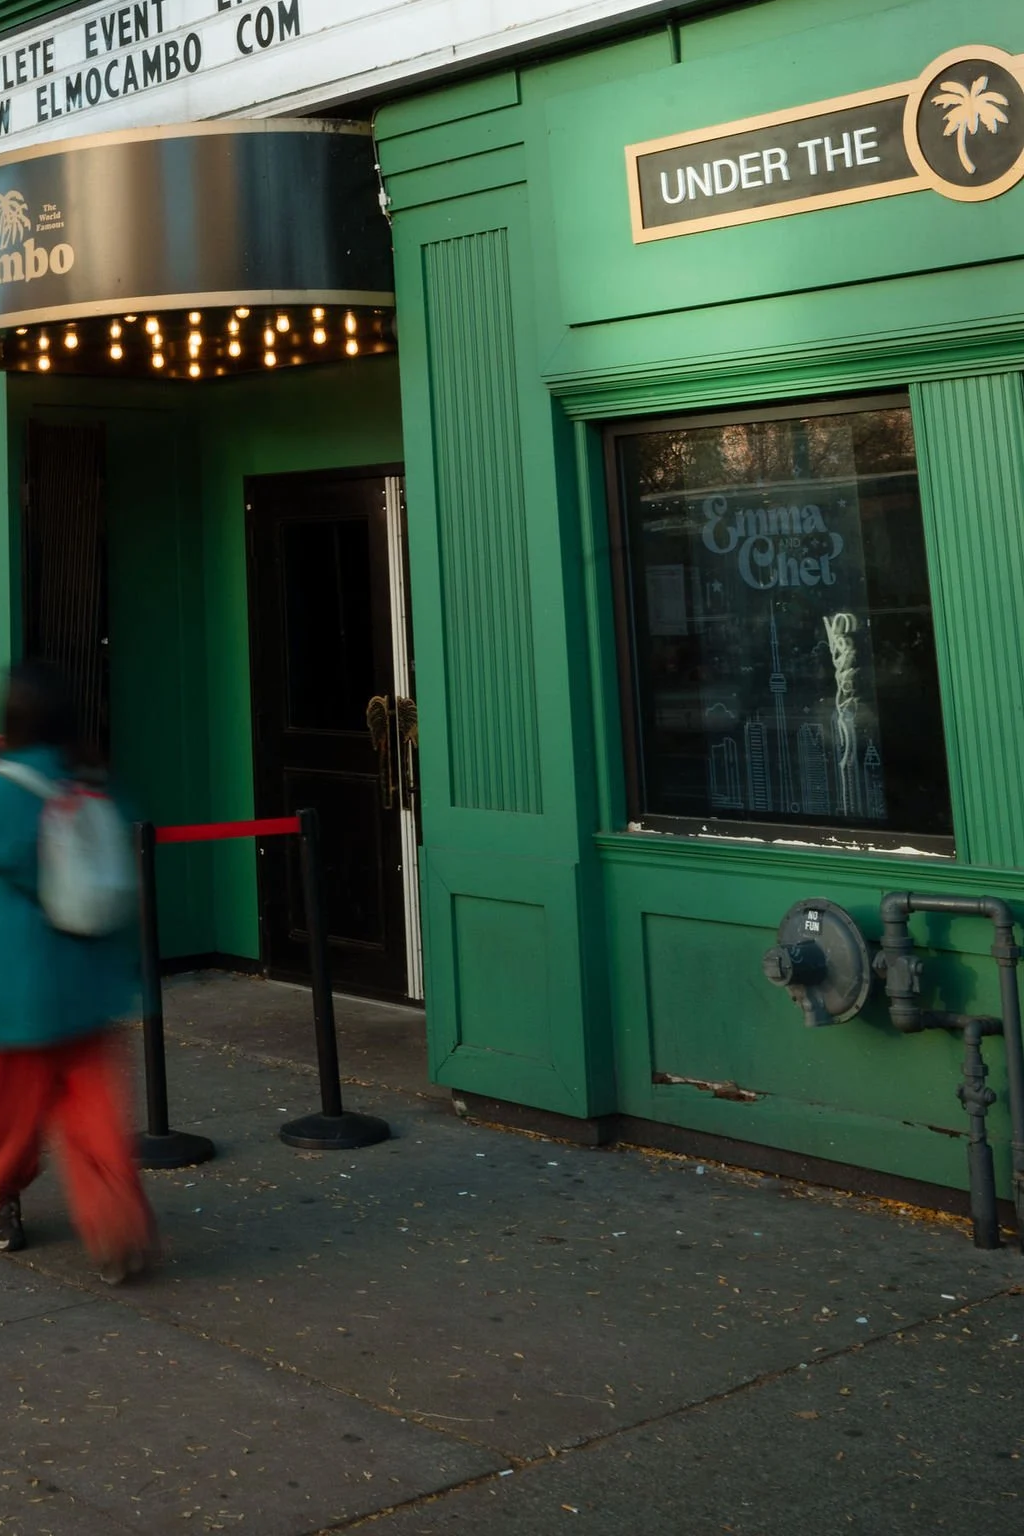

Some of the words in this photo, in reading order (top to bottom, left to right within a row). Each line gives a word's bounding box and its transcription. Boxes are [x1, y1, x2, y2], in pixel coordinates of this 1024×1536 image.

[36, 32, 202, 123] ELMOCAMBO
[660, 147, 791, 204] UNDER
[798, 126, 881, 175] THE
[42, 204, 57, 213] The
[39, 211, 61, 222] World
[36, 221, 65, 232] Famous
[701, 495, 828, 554] Emma
[778, 537, 801, 549] AND
[737, 531, 844, 590] Chet
[808, 910, 819, 920] NO
[805, 920, 820, 932] FUN
